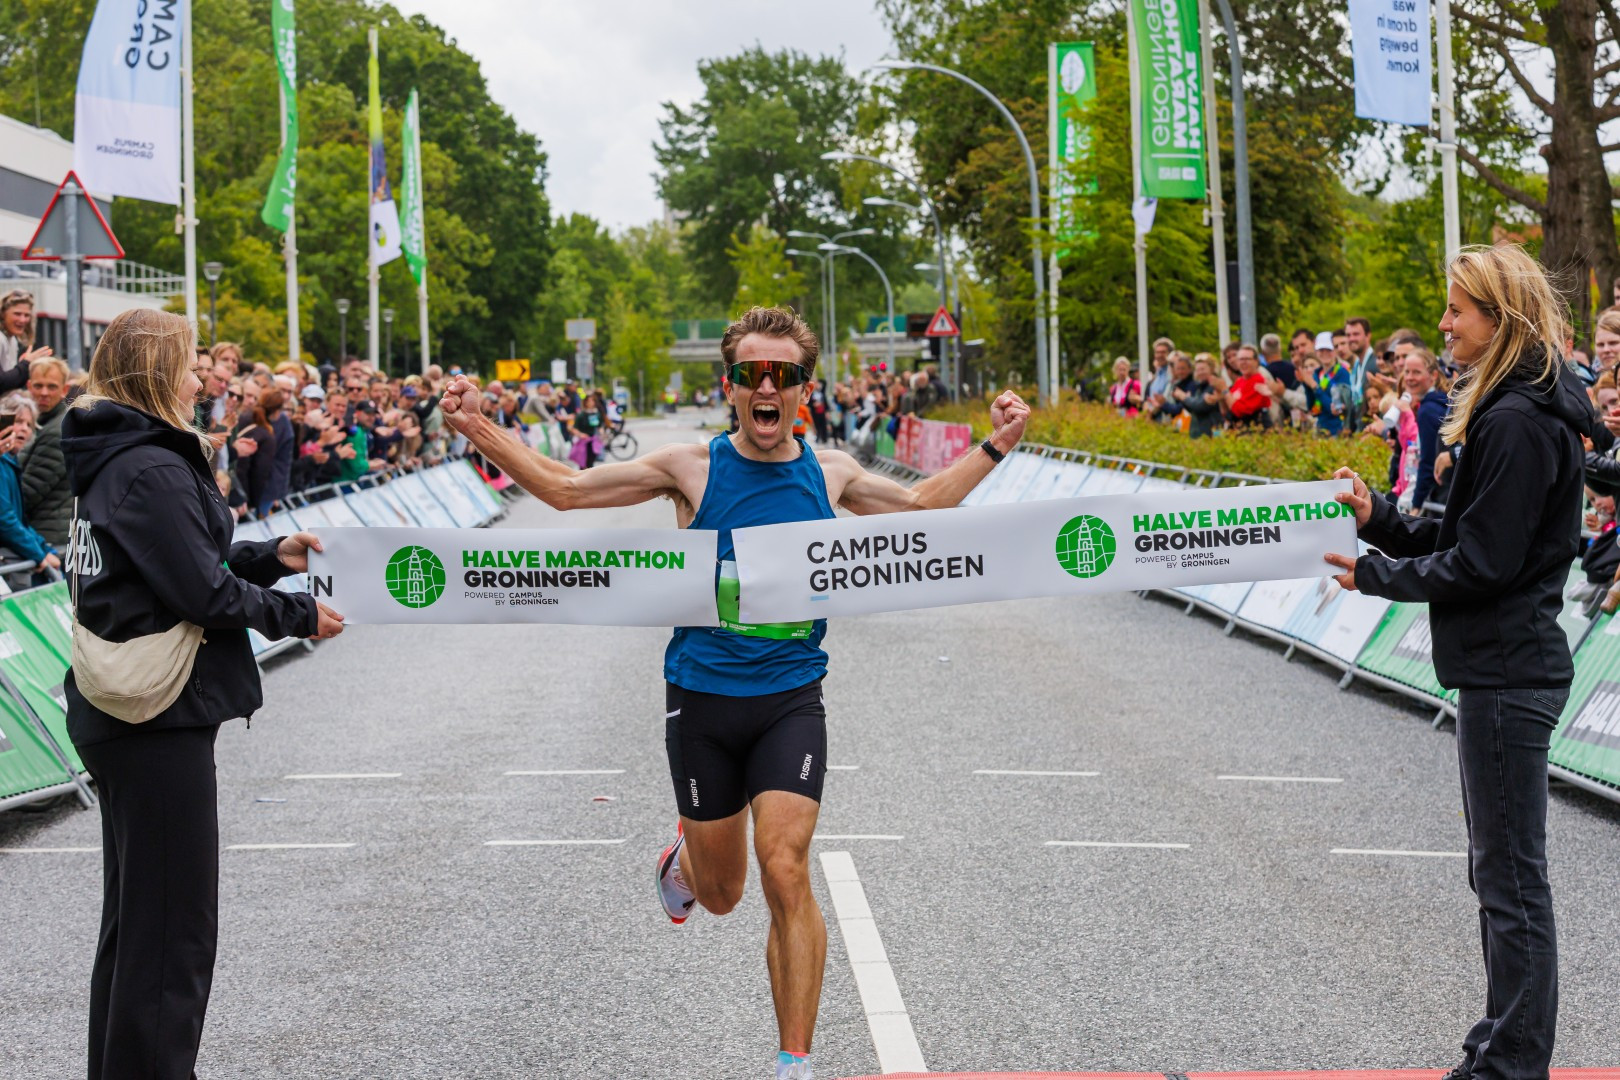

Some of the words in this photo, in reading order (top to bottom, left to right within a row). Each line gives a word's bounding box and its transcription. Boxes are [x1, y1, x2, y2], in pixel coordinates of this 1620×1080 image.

[1133, 510, 1212, 533] HALVE
[1217, 501, 1356, 527] MARATHON
[806, 531, 928, 564] CAMPUS
[1134, 526, 1282, 553] GRONINGEN
[462, 550, 540, 568] HALVE
[545, 550, 685, 570] MARATHON
[1135, 554, 1177, 564] POWERED
[1181, 552, 1215, 561] CAMPUS
[1181, 558, 1230, 568] GRONINGEN
[464, 570, 611, 588] GRONINGEN
[809, 554, 984, 592] GRONINGEN
[308, 575, 333, 598] N
[464, 591, 505, 599] POWERED
[509, 591, 543, 599] CAMPUS
[509, 598, 559, 606] GRONINGEN
[800, 753, 813, 780] FUSION
[689, 778, 700, 807] FUSION
